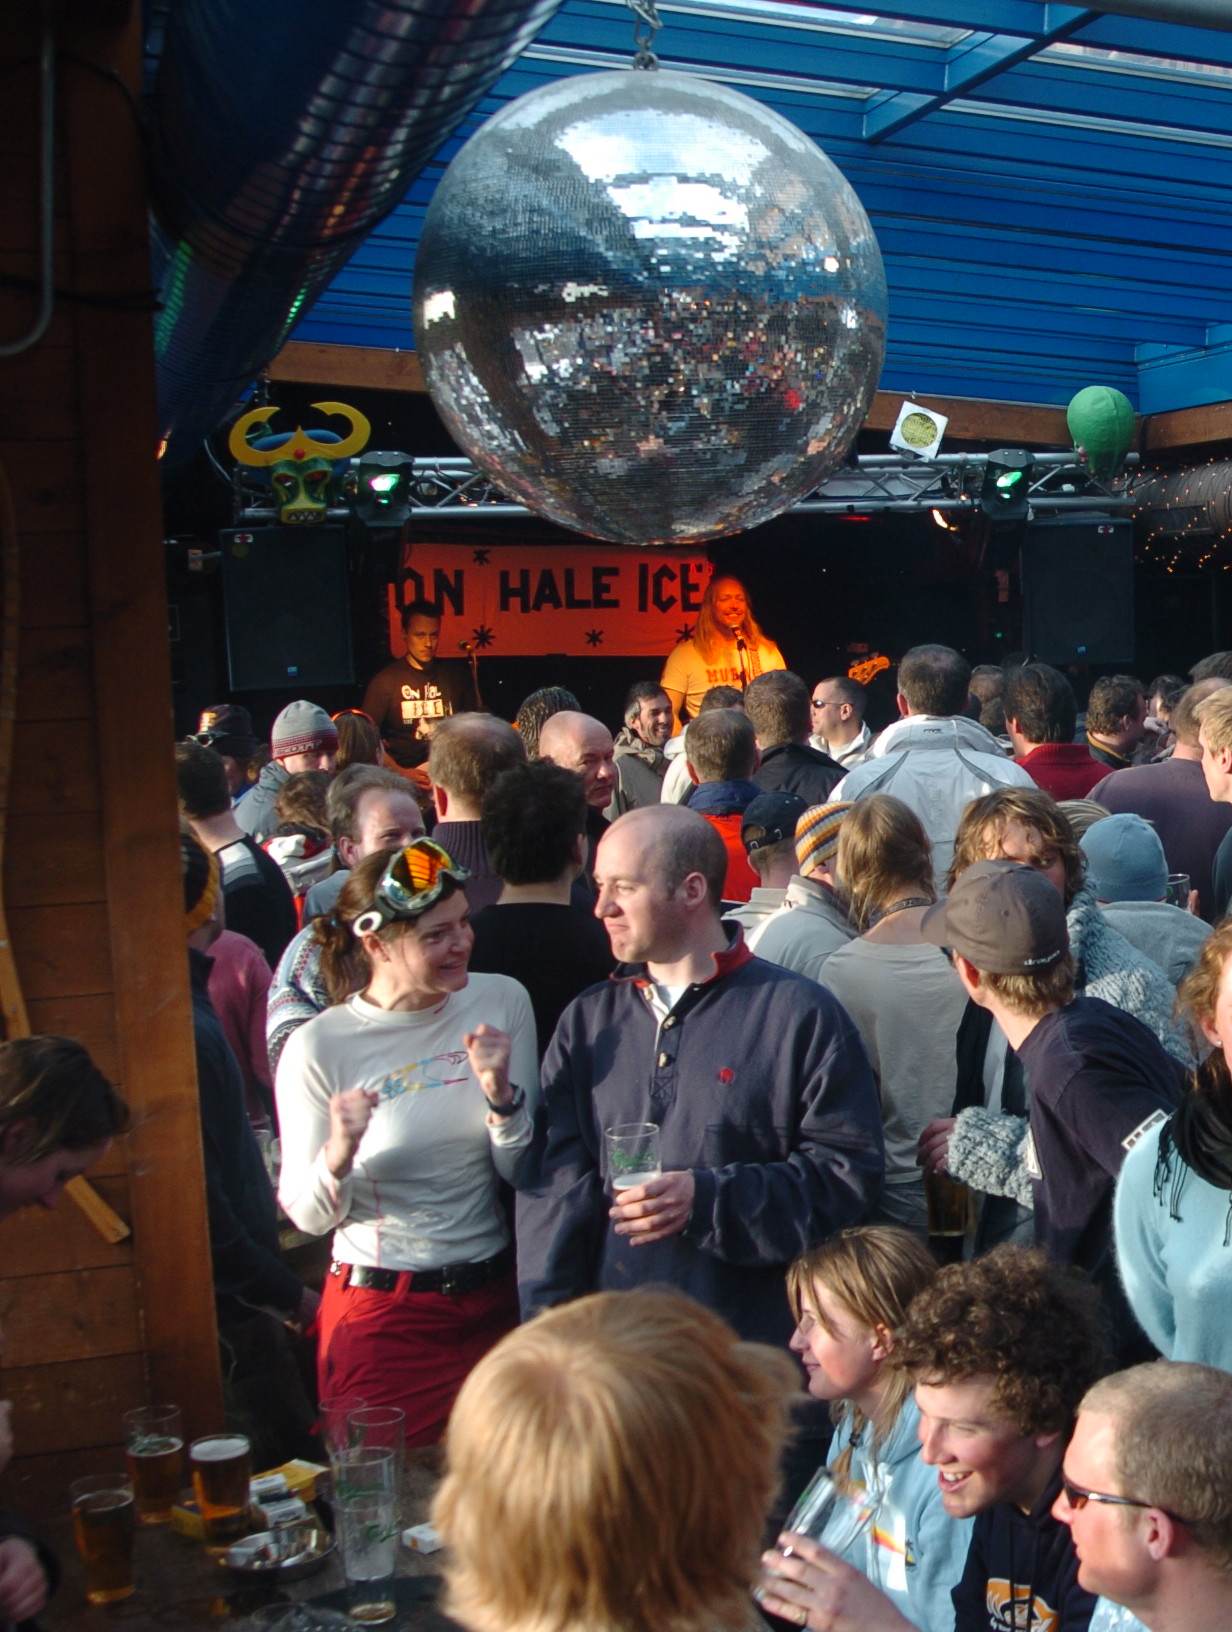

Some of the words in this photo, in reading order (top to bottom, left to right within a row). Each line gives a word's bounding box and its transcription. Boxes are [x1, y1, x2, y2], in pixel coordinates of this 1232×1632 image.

[396, 566, 464, 616] ON
[500, 566, 620, 613] HALE
[638, 563, 702, 613] ICE
